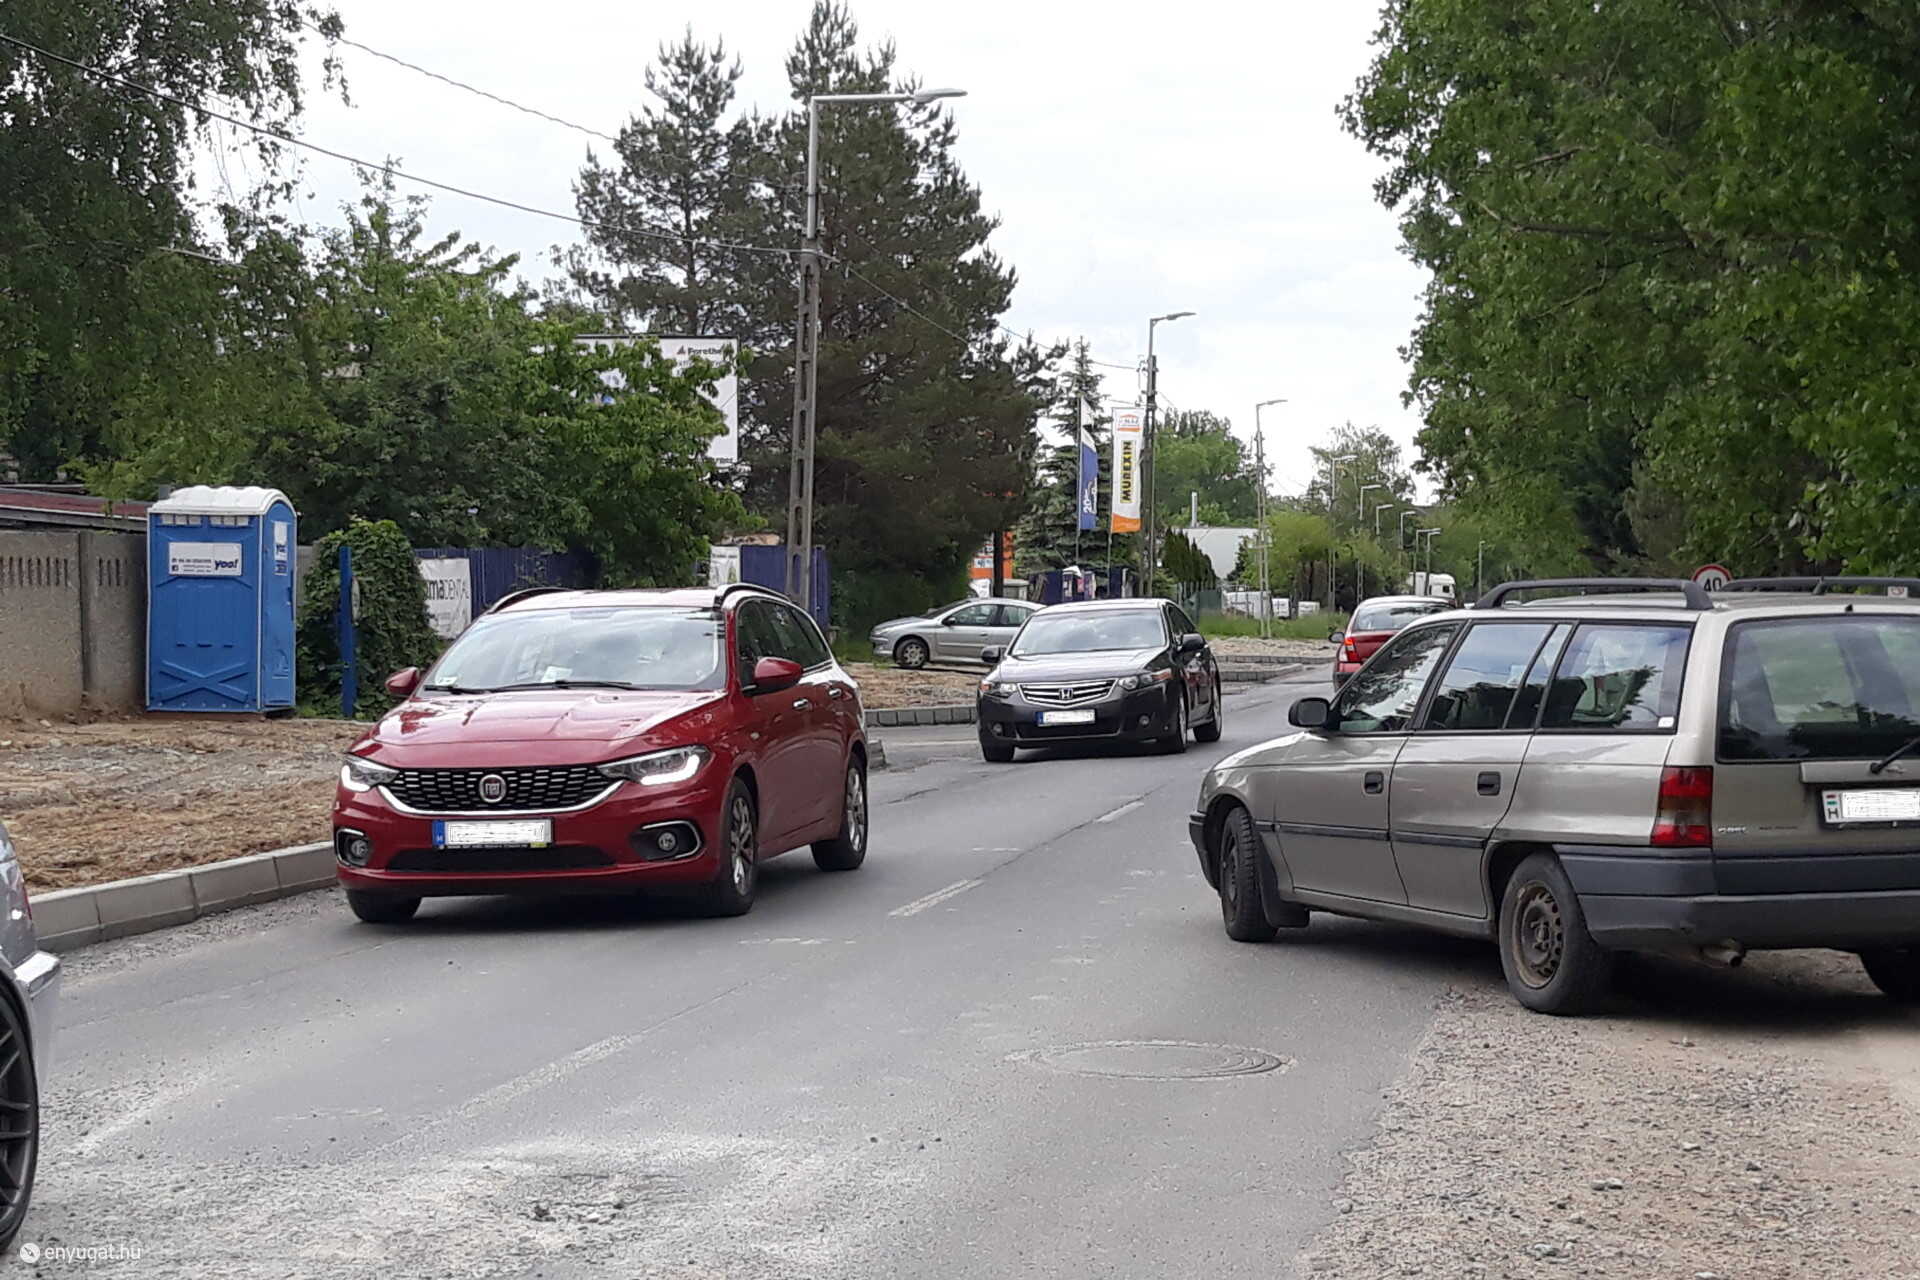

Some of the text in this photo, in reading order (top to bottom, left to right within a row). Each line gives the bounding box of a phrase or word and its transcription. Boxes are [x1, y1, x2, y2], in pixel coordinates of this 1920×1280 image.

[1122, 441, 1132, 501] MUREXIN
[1703, 576, 1722, 592] 40
[1827, 807, 1840, 820] H
